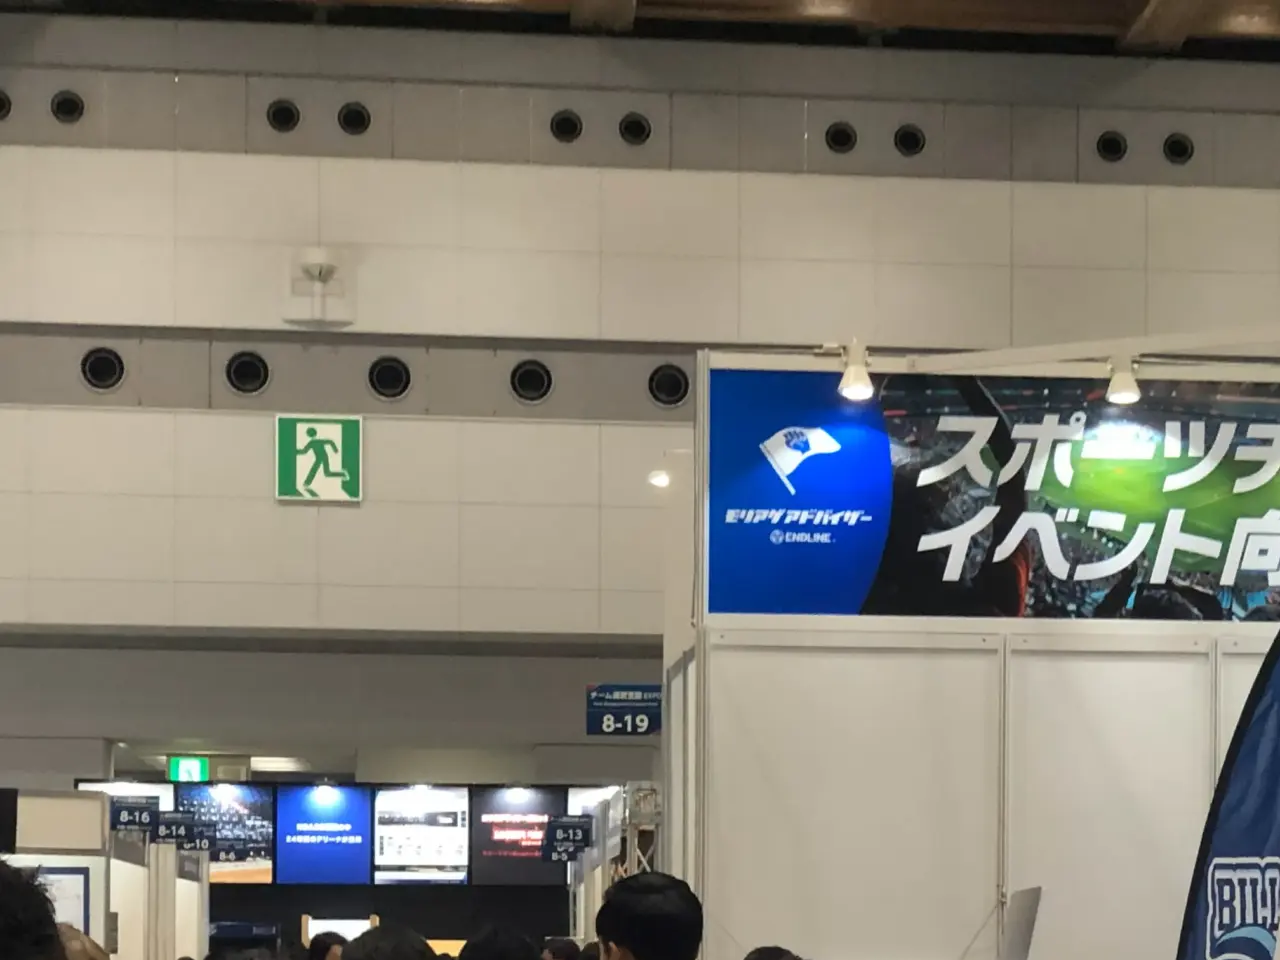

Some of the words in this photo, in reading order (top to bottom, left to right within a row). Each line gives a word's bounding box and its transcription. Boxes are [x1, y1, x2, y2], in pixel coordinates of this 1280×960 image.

[602, 714, 649, 732] 8-19
[119, 811, 150, 823] 8-16
[158, 825, 186, 836] 8-14
[556, 829, 582, 840] 8-13
